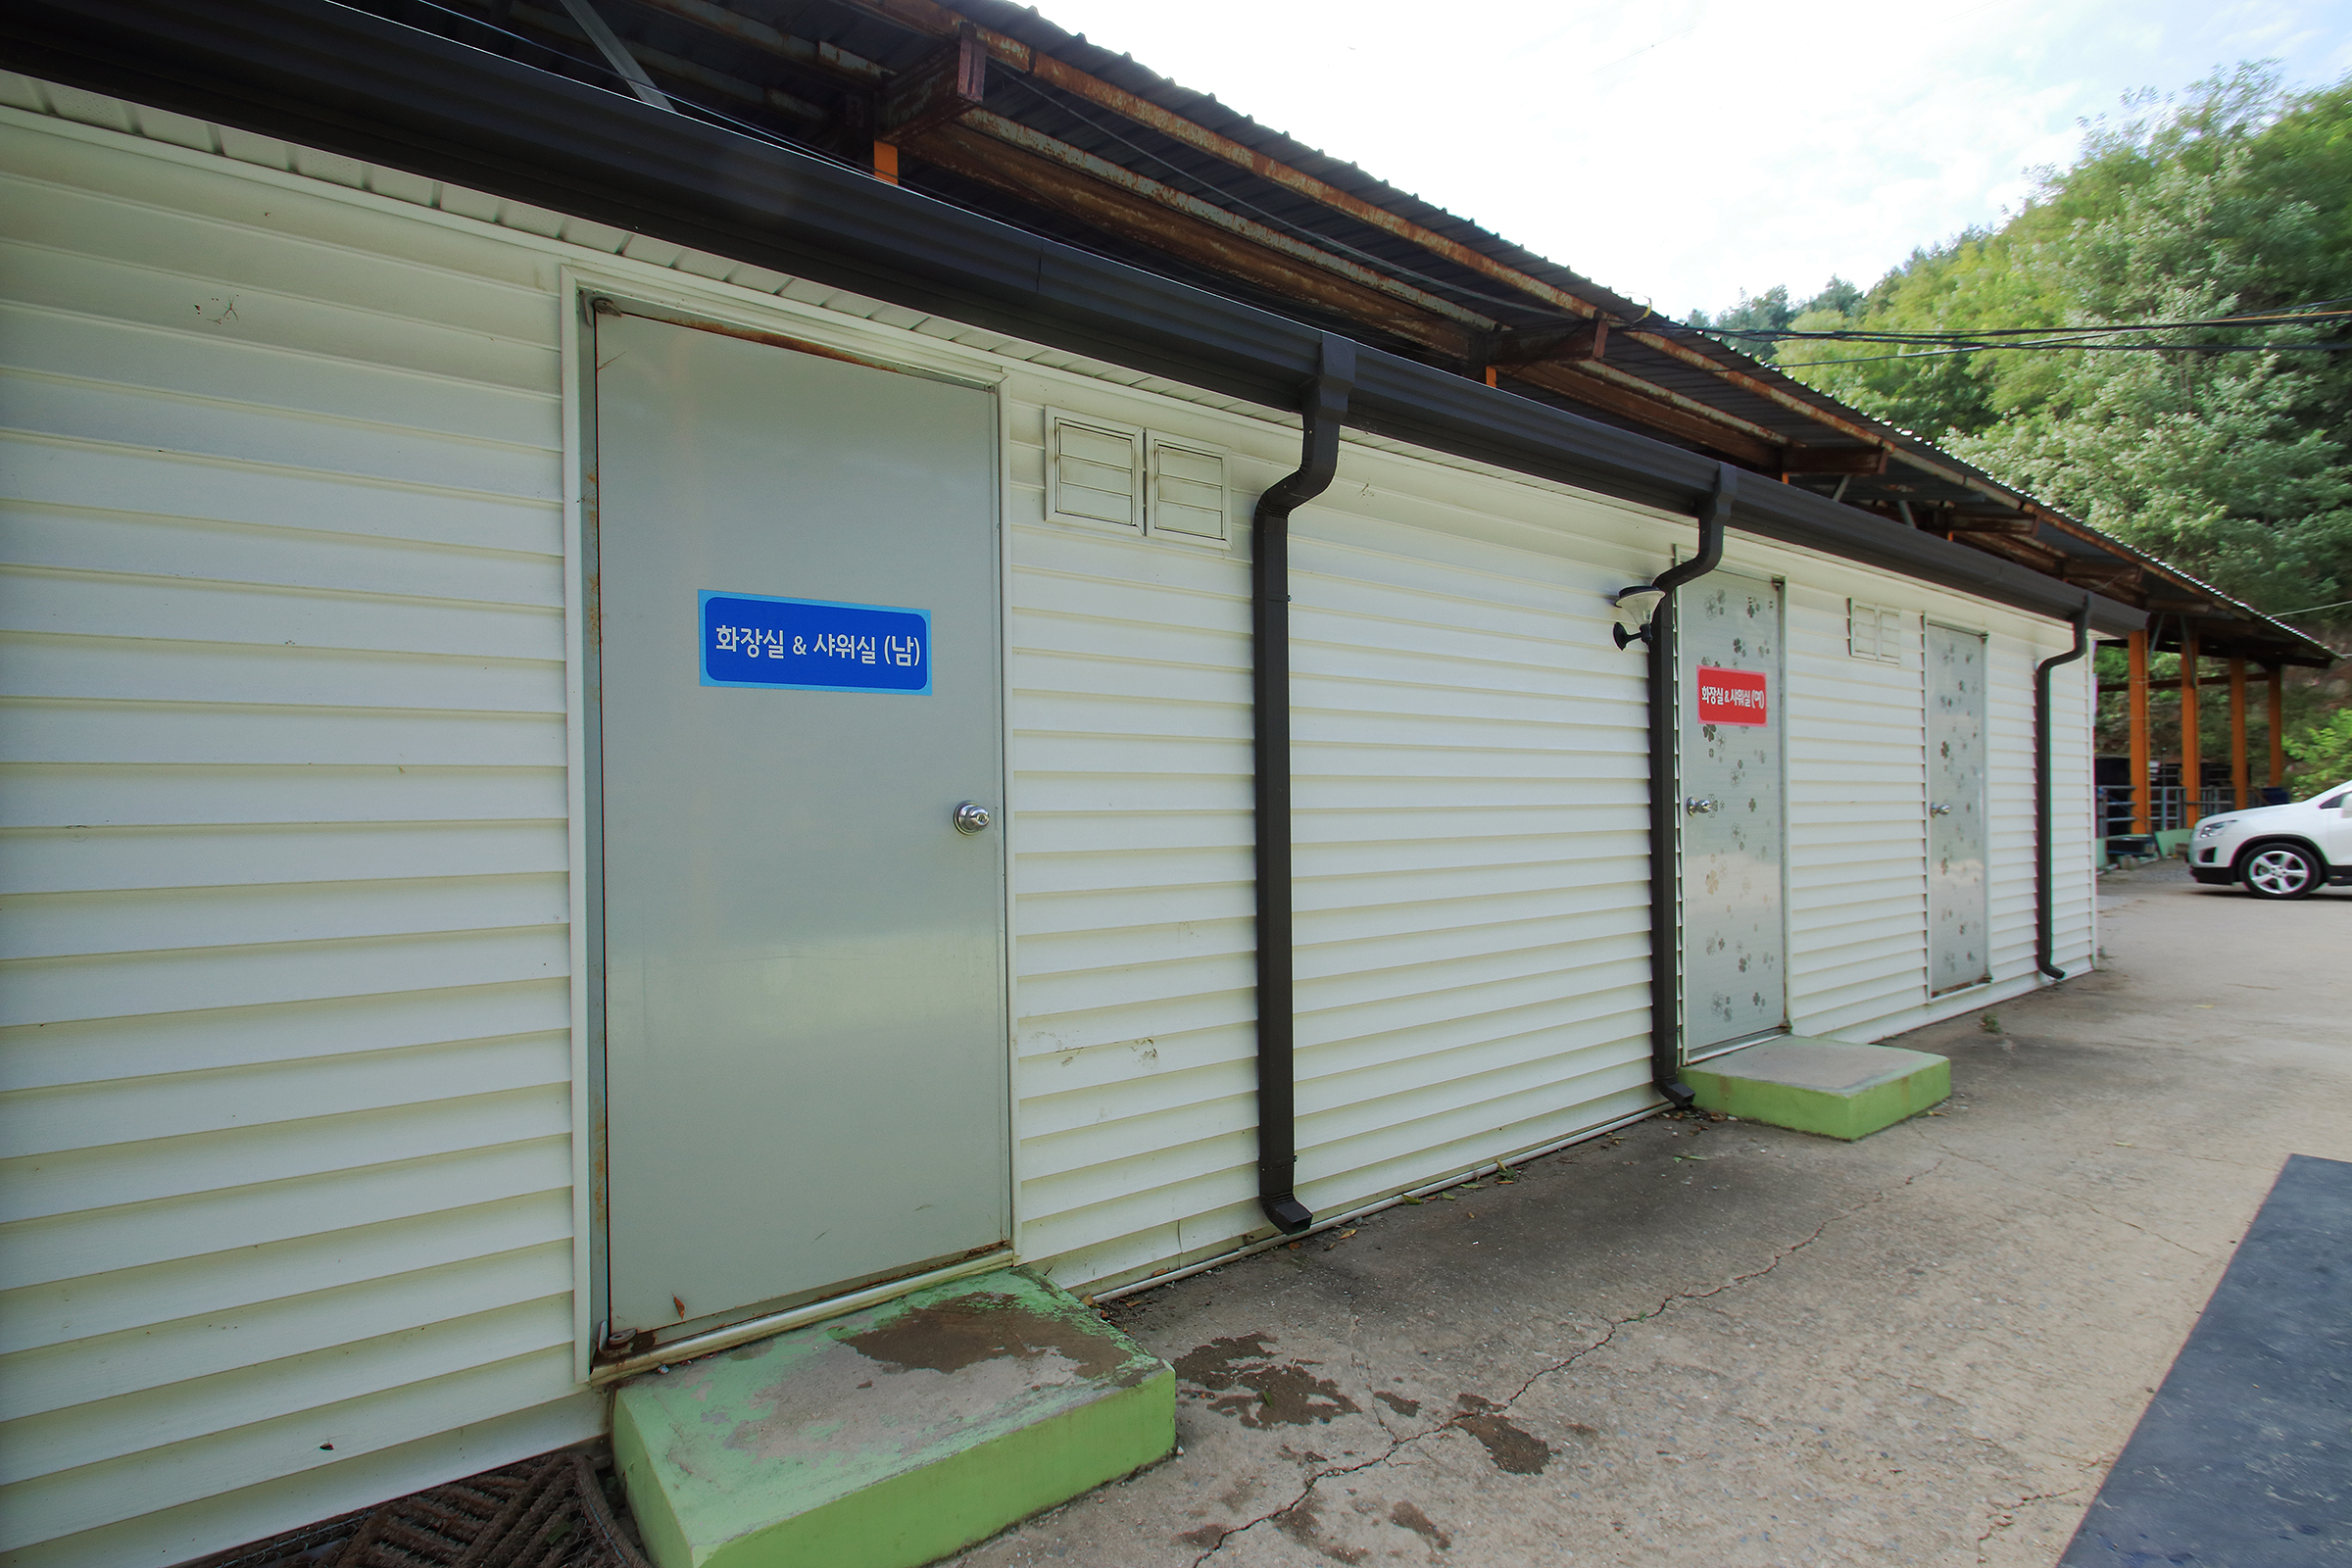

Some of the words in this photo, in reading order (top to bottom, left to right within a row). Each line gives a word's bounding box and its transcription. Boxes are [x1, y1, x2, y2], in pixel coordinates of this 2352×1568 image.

[715, 624, 784, 660] 화장실
[792, 635, 808, 656] &
[812, 633, 876, 664] 샤워실
[884, 635, 921, 667] (남)
[1701, 685, 1724, 706] 화장실
[1724, 690, 1731, 703] &
[1730, 688, 1751, 708] 샤워실
[1751, 689, 1765, 710] (여)
